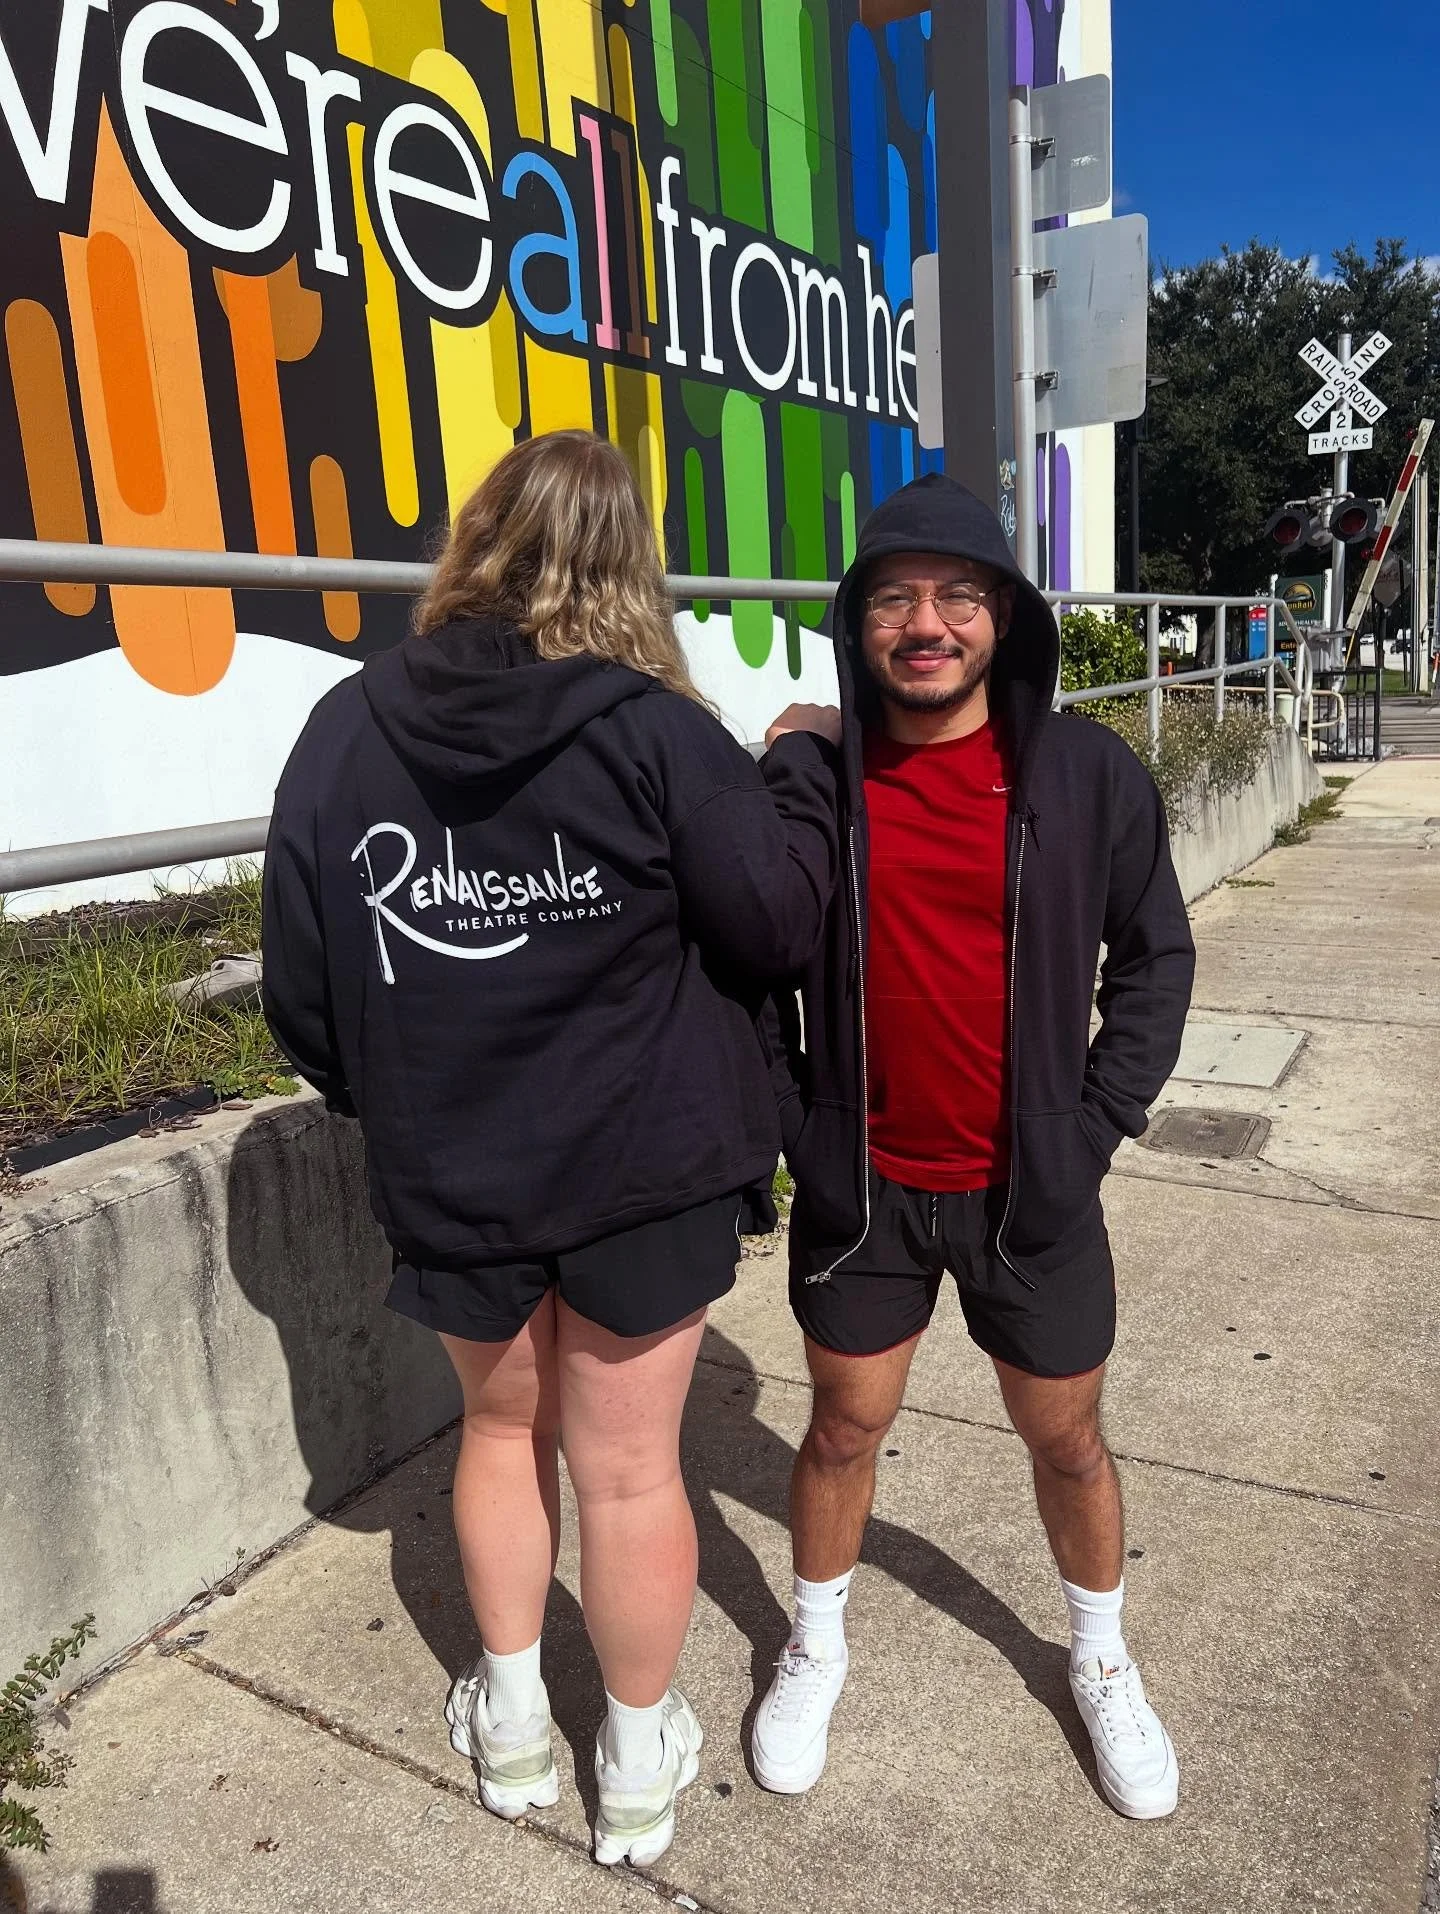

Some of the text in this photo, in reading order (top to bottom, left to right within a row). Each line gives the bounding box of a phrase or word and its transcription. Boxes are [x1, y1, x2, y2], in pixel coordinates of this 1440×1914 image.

[502, 114, 651, 359] all
[657, 156, 857, 407] from
[1336, 414, 1346, 429] 2
[1312, 433, 1369, 449] TRACKS
[445, 900, 623, 932] THEATRE COMPANY
